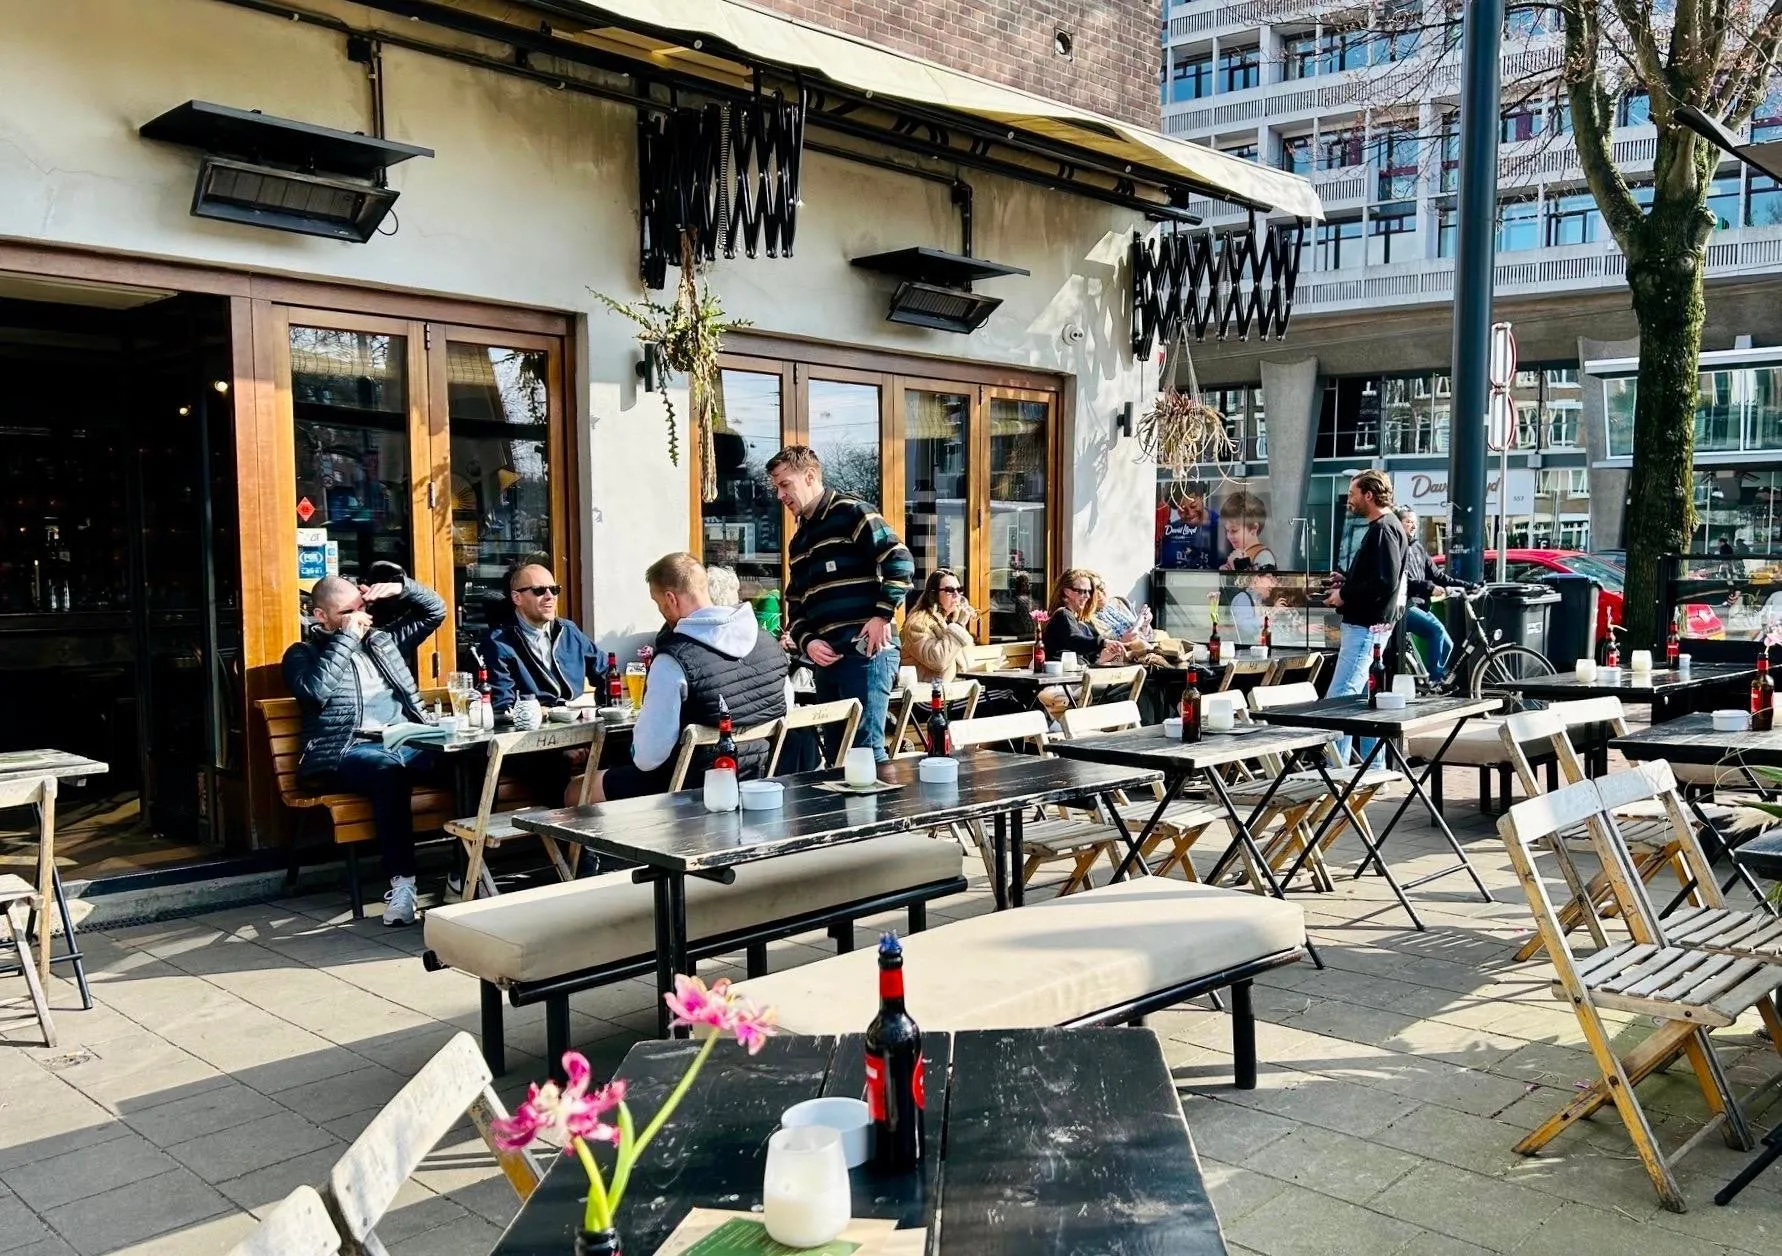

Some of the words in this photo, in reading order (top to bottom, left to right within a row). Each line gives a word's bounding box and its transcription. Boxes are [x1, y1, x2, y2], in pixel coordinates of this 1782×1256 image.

[1411, 474, 1448, 499] Dav
[1165, 524, 1183, 536] David
[1182, 524, 1198, 535] Lloyd
